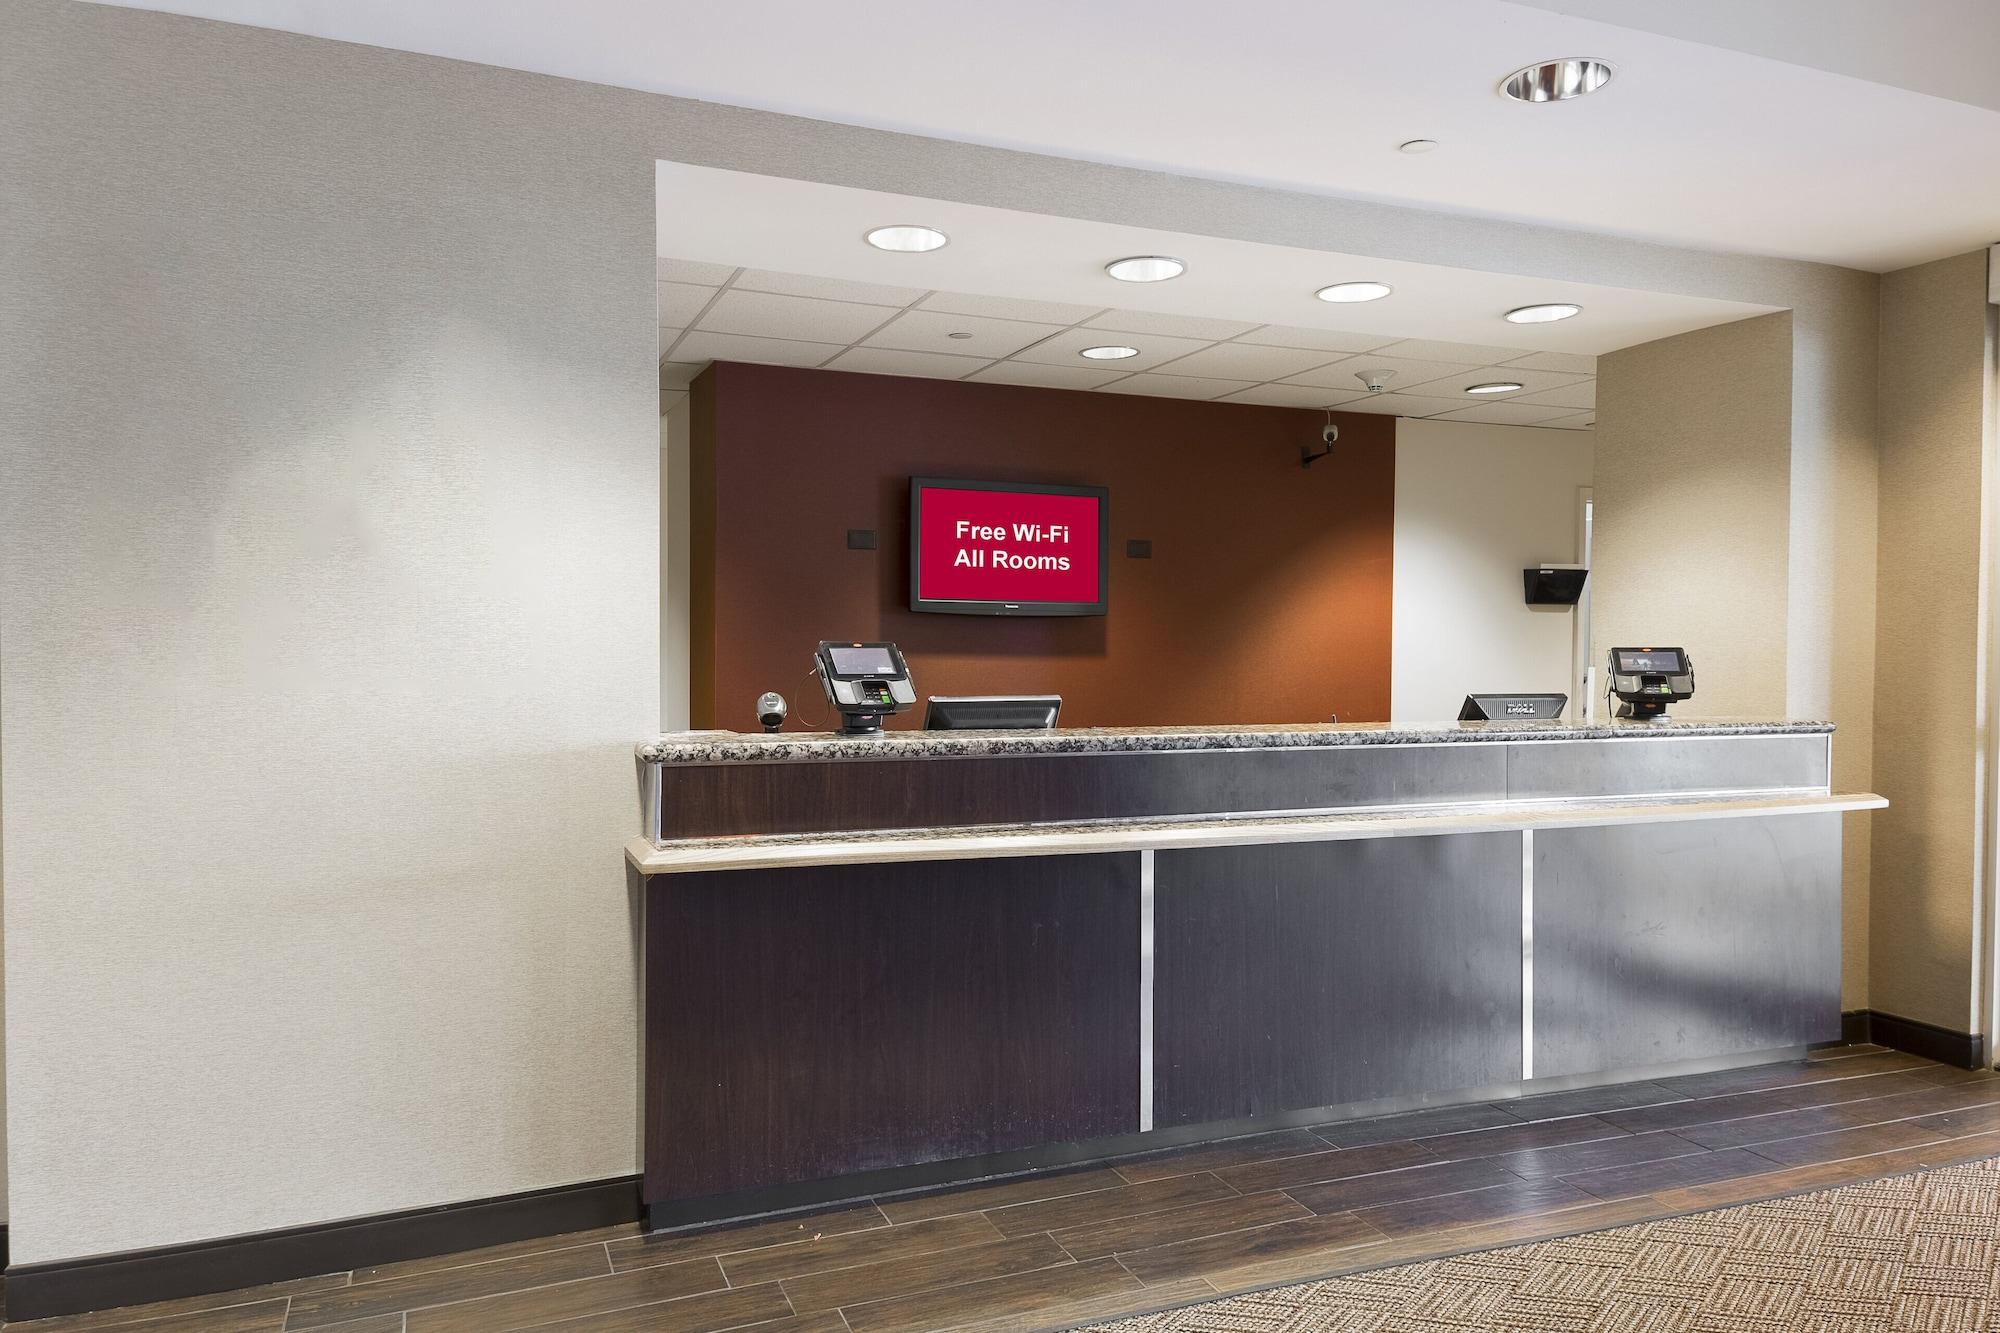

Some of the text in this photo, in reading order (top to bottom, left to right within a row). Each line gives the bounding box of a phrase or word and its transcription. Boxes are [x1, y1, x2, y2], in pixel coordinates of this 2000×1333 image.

[956, 520, 1069, 543] Free Wi-Fi
[954, 549, 1071, 571] All Rooms
